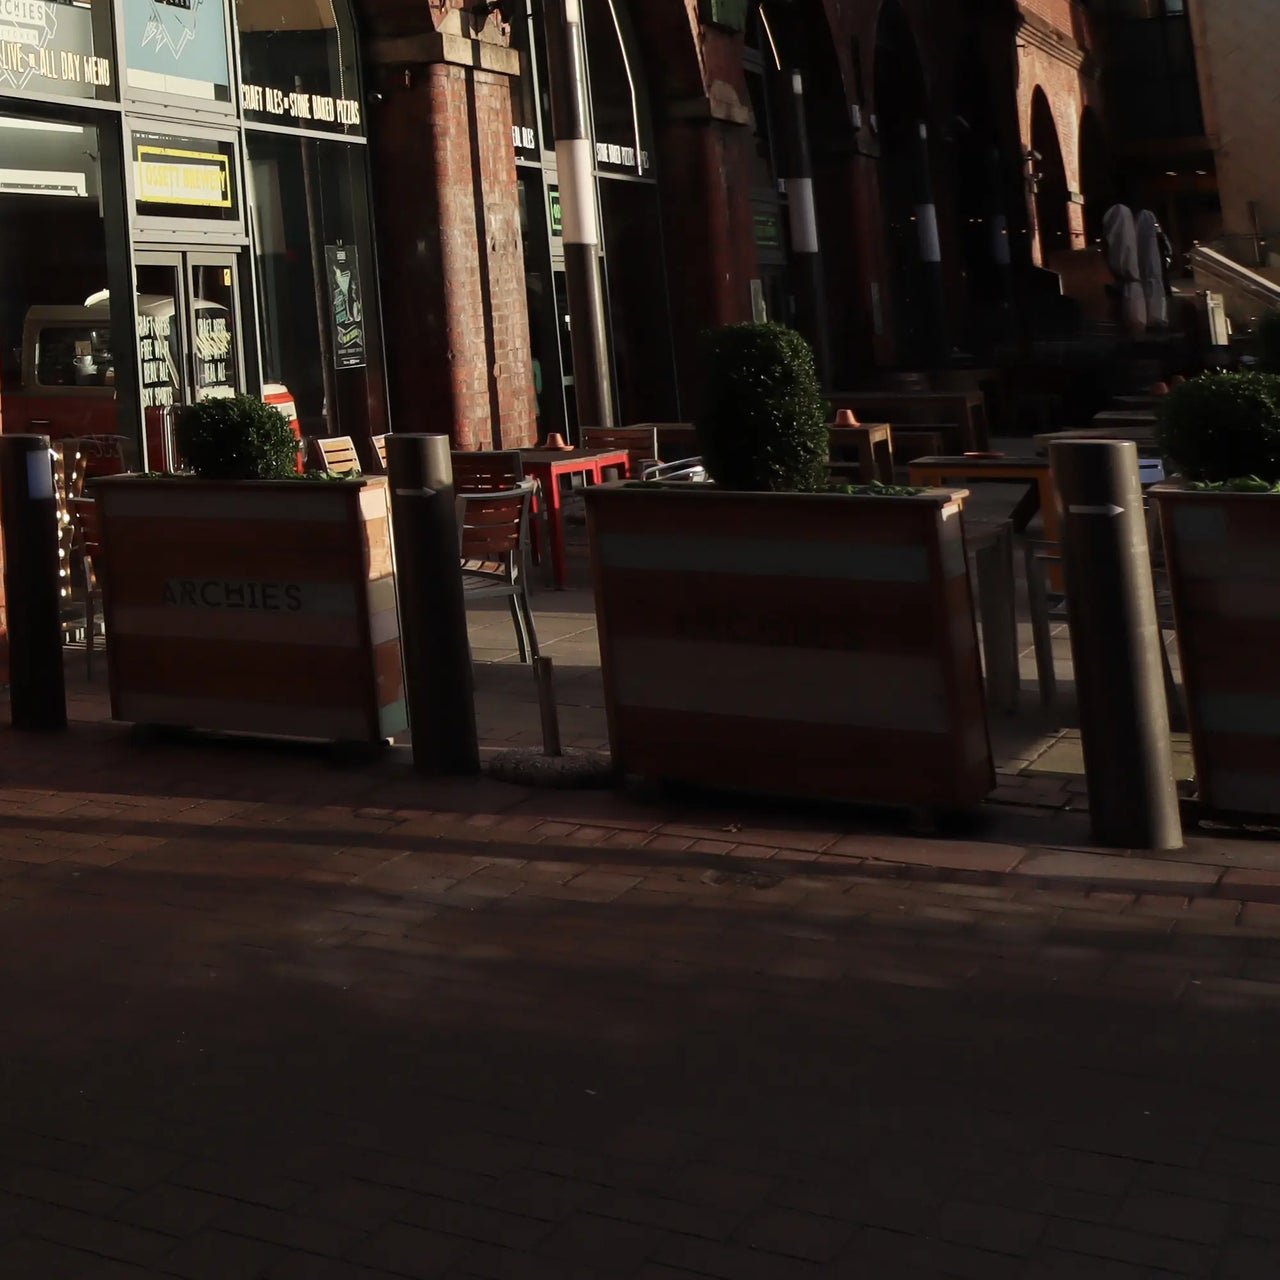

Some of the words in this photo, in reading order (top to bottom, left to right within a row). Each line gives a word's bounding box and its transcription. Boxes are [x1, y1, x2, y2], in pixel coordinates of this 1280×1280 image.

[2, 40, 25, 73] LIVE
[40, 48, 58, 79] ALL
[61, 51, 80, 82] DAY
[83, 55, 110, 87] MENU
[265, 87, 284, 115] ALES
[289, 92, 312, 119] STONE
[312, 95, 335, 122] BAKED
[336, 98, 360, 125] PIZZAS
